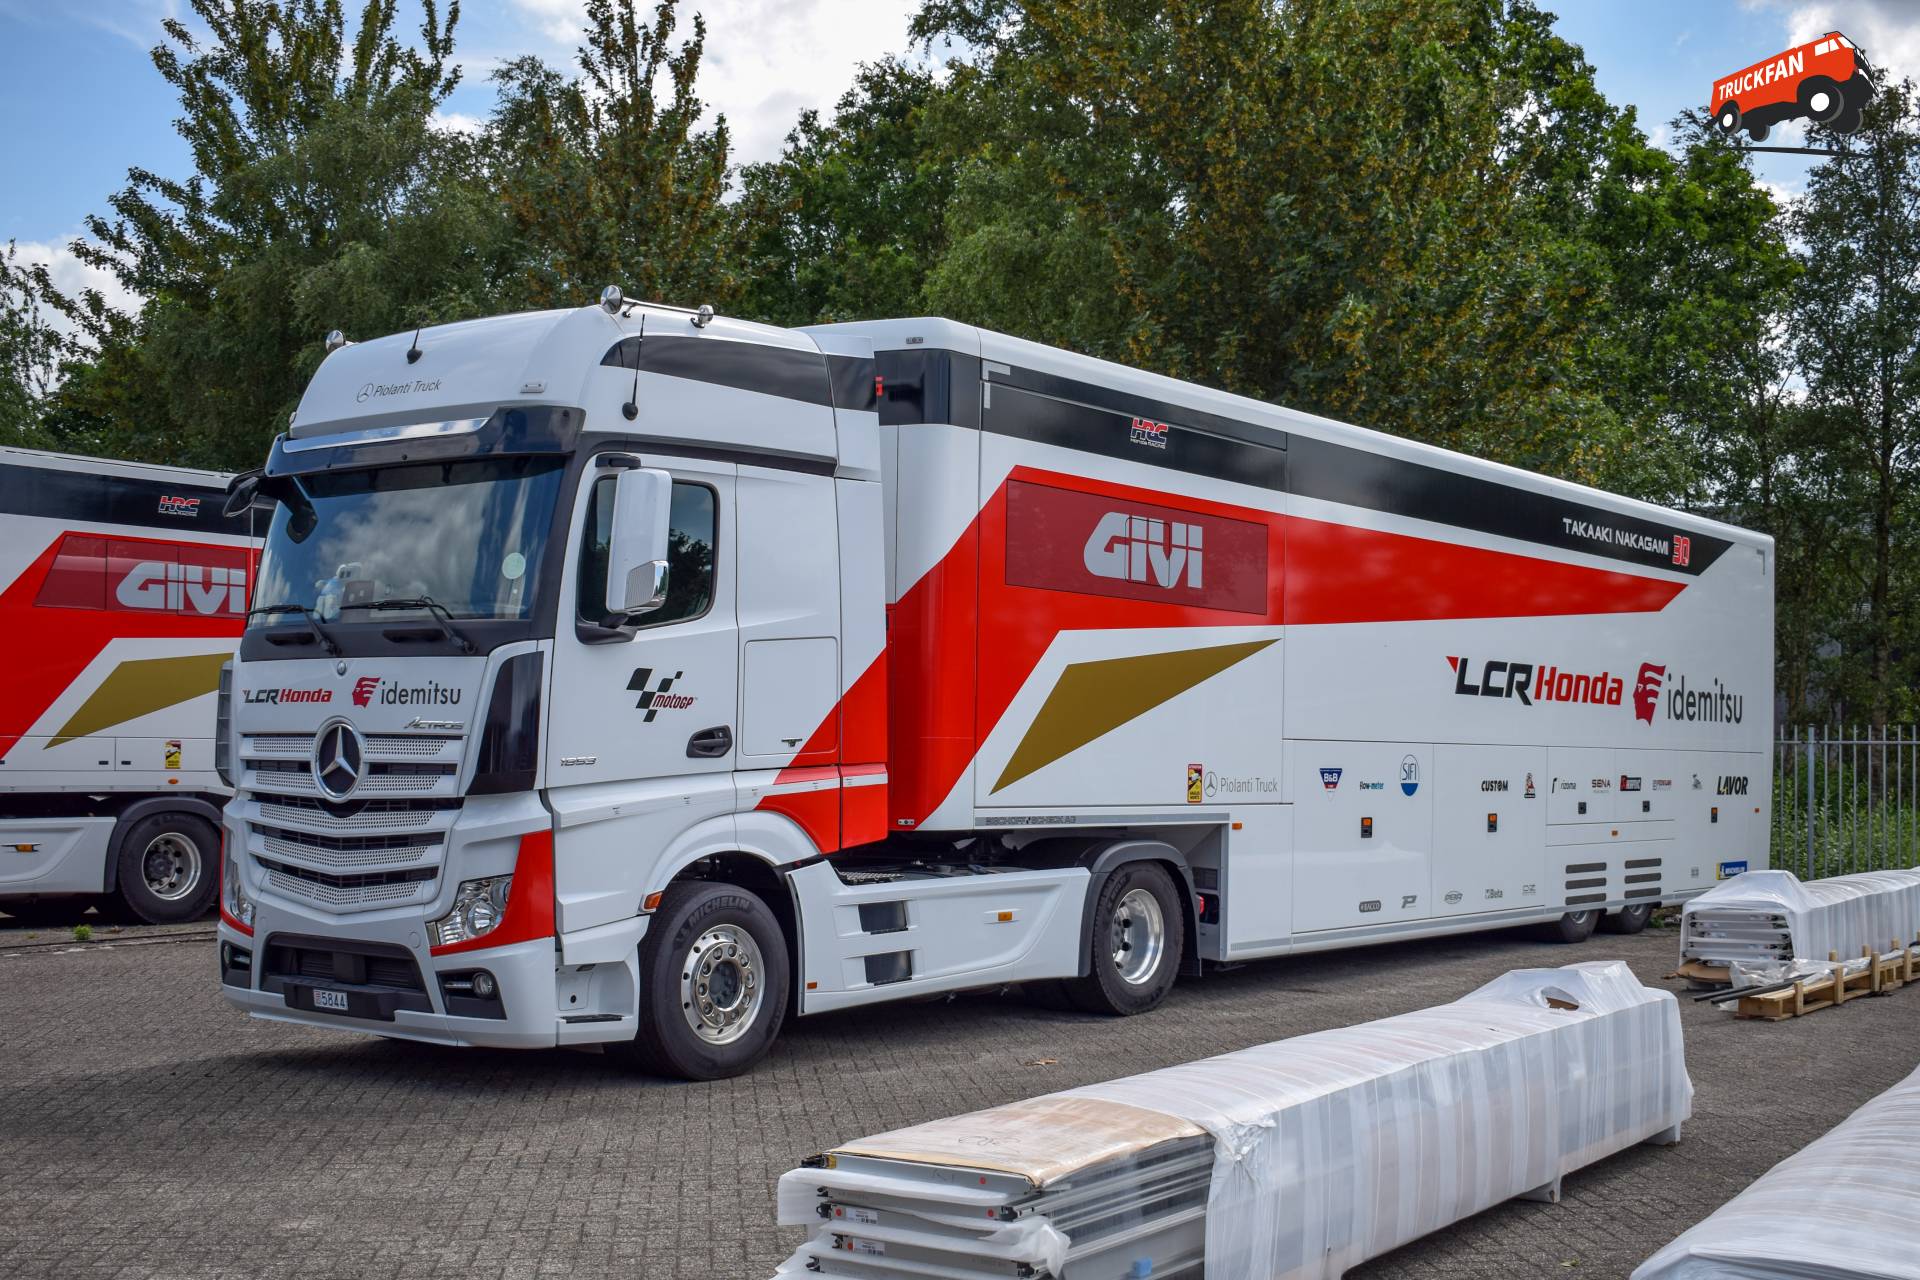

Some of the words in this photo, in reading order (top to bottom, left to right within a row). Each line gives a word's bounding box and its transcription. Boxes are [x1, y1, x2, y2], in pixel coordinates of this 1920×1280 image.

[373, 381, 411, 398] Piolanti
[413, 379, 441, 393] Truck
[1130, 417, 1169, 445] HRC
[158, 495, 200, 514] HRC
[1084, 511, 1203, 589] GIVI
[1562, 517, 1612, 543] TAKAAKI
[1615, 530, 1669, 555] NAKAGAMI
[1672, 534, 1691, 567] 30
[115, 562, 247, 614] GIVI
[381, 680, 461, 705] idemitsu
[1666, 672, 1743, 724] idemitsu
[1220, 777, 1252, 793] Piolanti
[1255, 777, 1278, 793] Truck
[1481, 780, 1508, 792] CUSTOM
[1592, 779, 1611, 788] SENA
[1717, 776, 1748, 795] LAVOR
[687, 895, 751, 926] MICHELIN
[321, 991, 346, 1008] 5844
